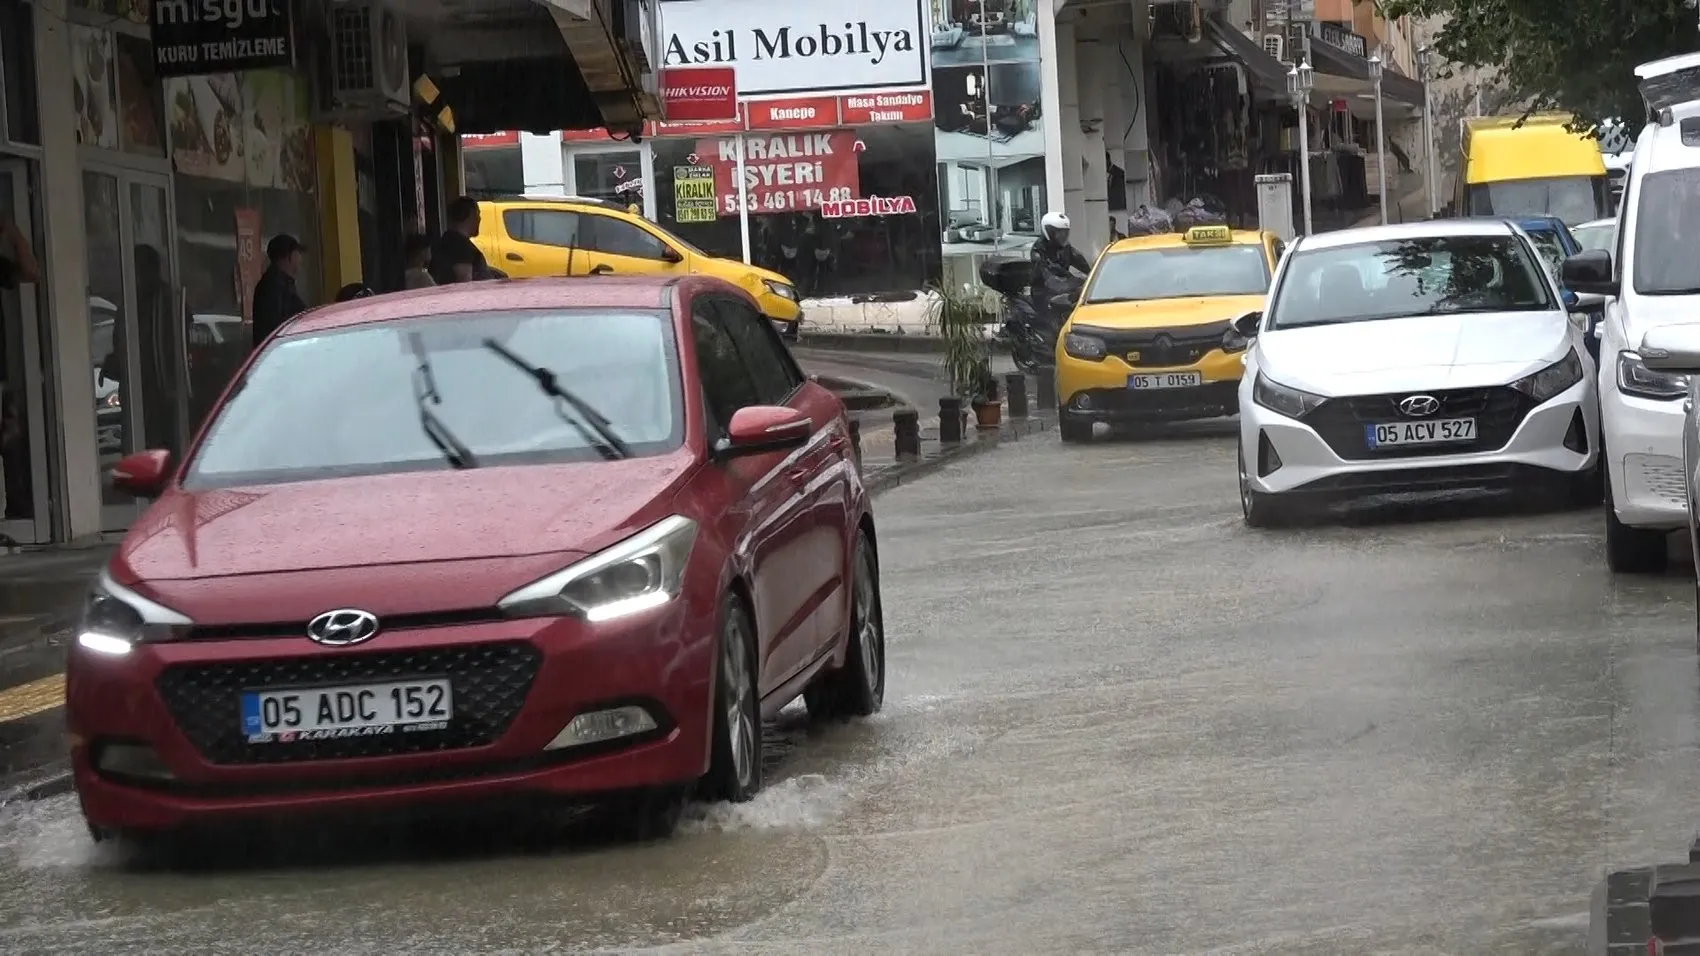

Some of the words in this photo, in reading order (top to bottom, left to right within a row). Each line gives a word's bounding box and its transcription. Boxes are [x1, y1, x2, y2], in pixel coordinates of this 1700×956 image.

[157, 45, 198, 63] KURU
[202, 37, 285, 60] TEMİZLEME
[664, 30, 738, 65] Asil
[752, 22, 914, 64] Mobilya
[665, 86, 731, 97] HIKVISION
[848, 98, 875, 109] Masa
[877, 94, 923, 107] Sandalye
[770, 107, 816, 121] Kanepe
[719, 134, 833, 161] KRALIK
[764, 190, 794, 209] 461
[802, 188, 823, 207] 14
[822, 195, 916, 218] MOBİLYA
[1134, 375, 1149, 388] 05
[1156, 376, 1161, 386] T
[1168, 374, 1195, 386] 0159
[1377, 425, 1398, 442] 05
[1404, 422, 1435, 441] ACV
[1441, 420, 1472, 438] 527
[263, 696, 301, 727] 05
[317, 690, 376, 725] ADC
[391, 685, 445, 719] 152
